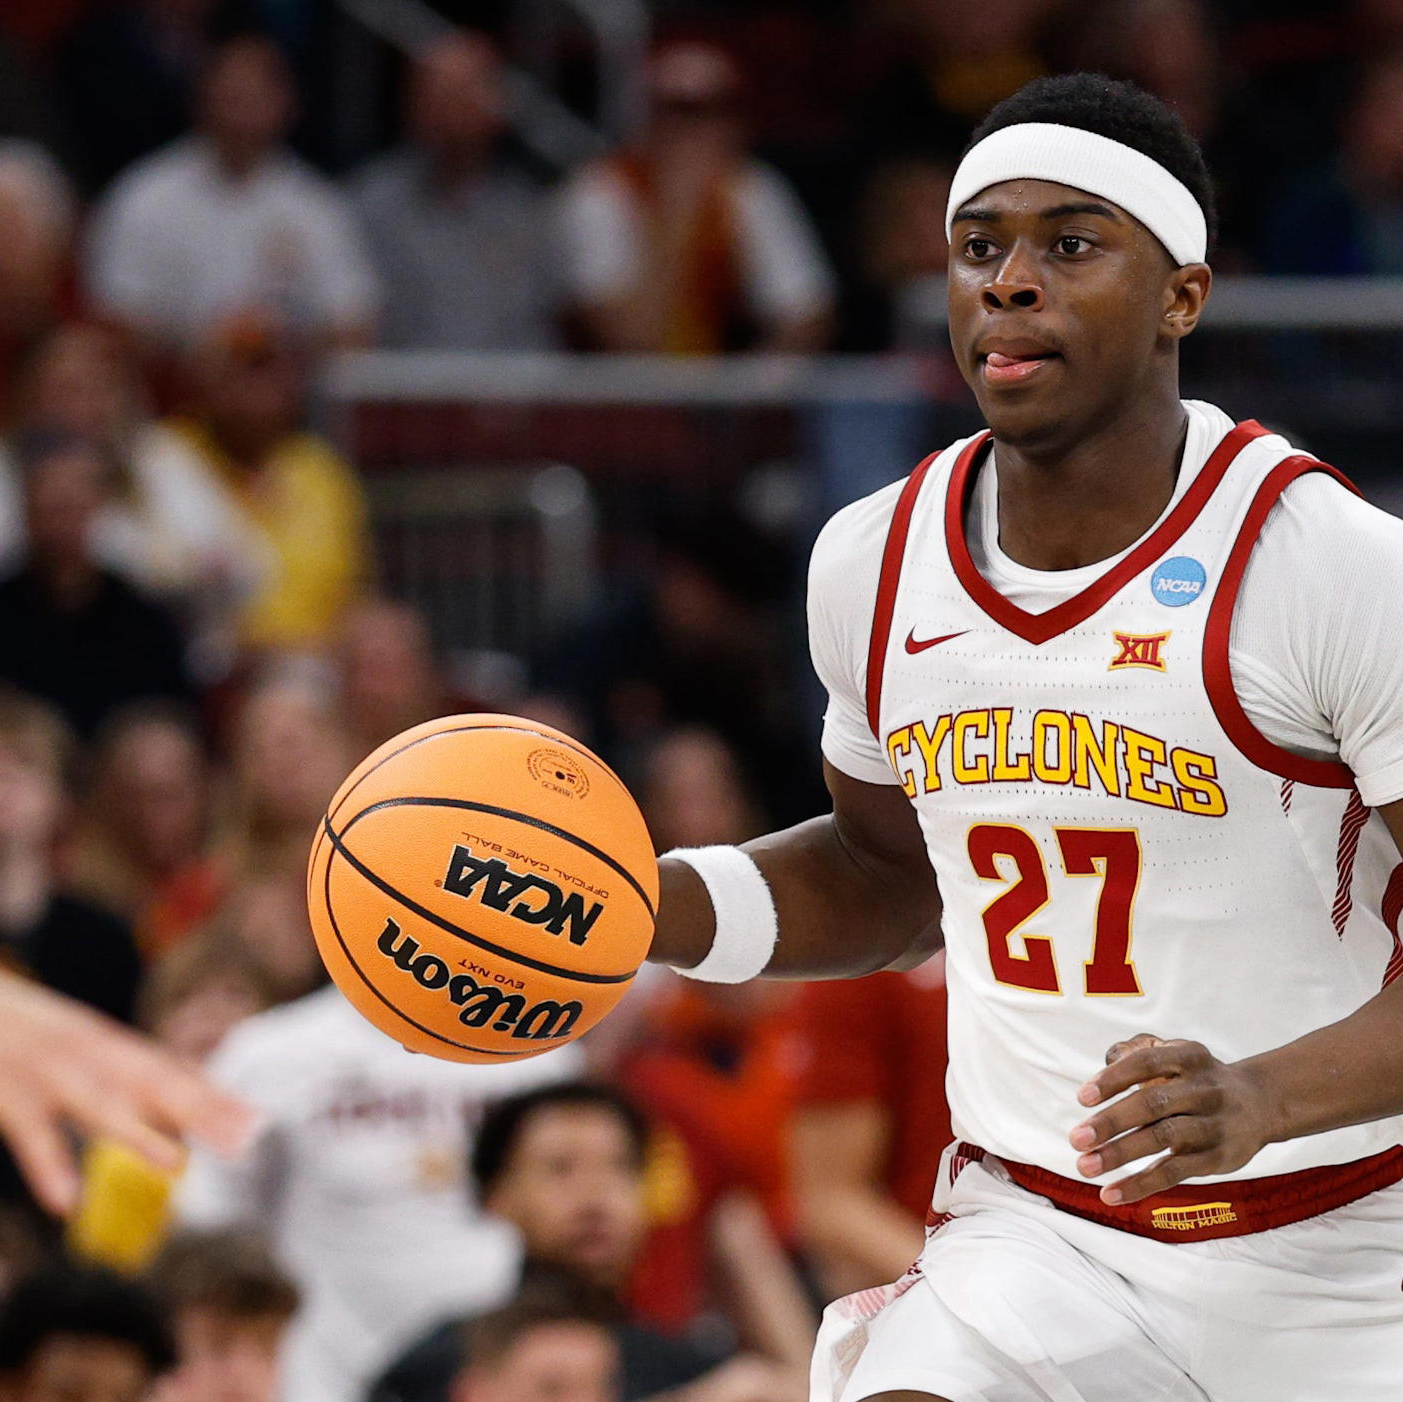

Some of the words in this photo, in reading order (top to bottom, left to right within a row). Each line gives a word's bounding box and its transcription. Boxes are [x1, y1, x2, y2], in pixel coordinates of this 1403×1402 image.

[1156, 576, 1202, 595] NCAA
[887, 707, 1228, 818] CYCLONES
[461, 831, 503, 855] BALL
[505, 848, 551, 874] GAME
[441, 843, 605, 947] NCAA
[553, 867, 610, 899] OFFICIAL
[966, 822, 1144, 997] 27
[375, 916, 584, 1040] Wilson
[457, 958, 492, 978] NXT
[493, 974, 525, 990] EVO
